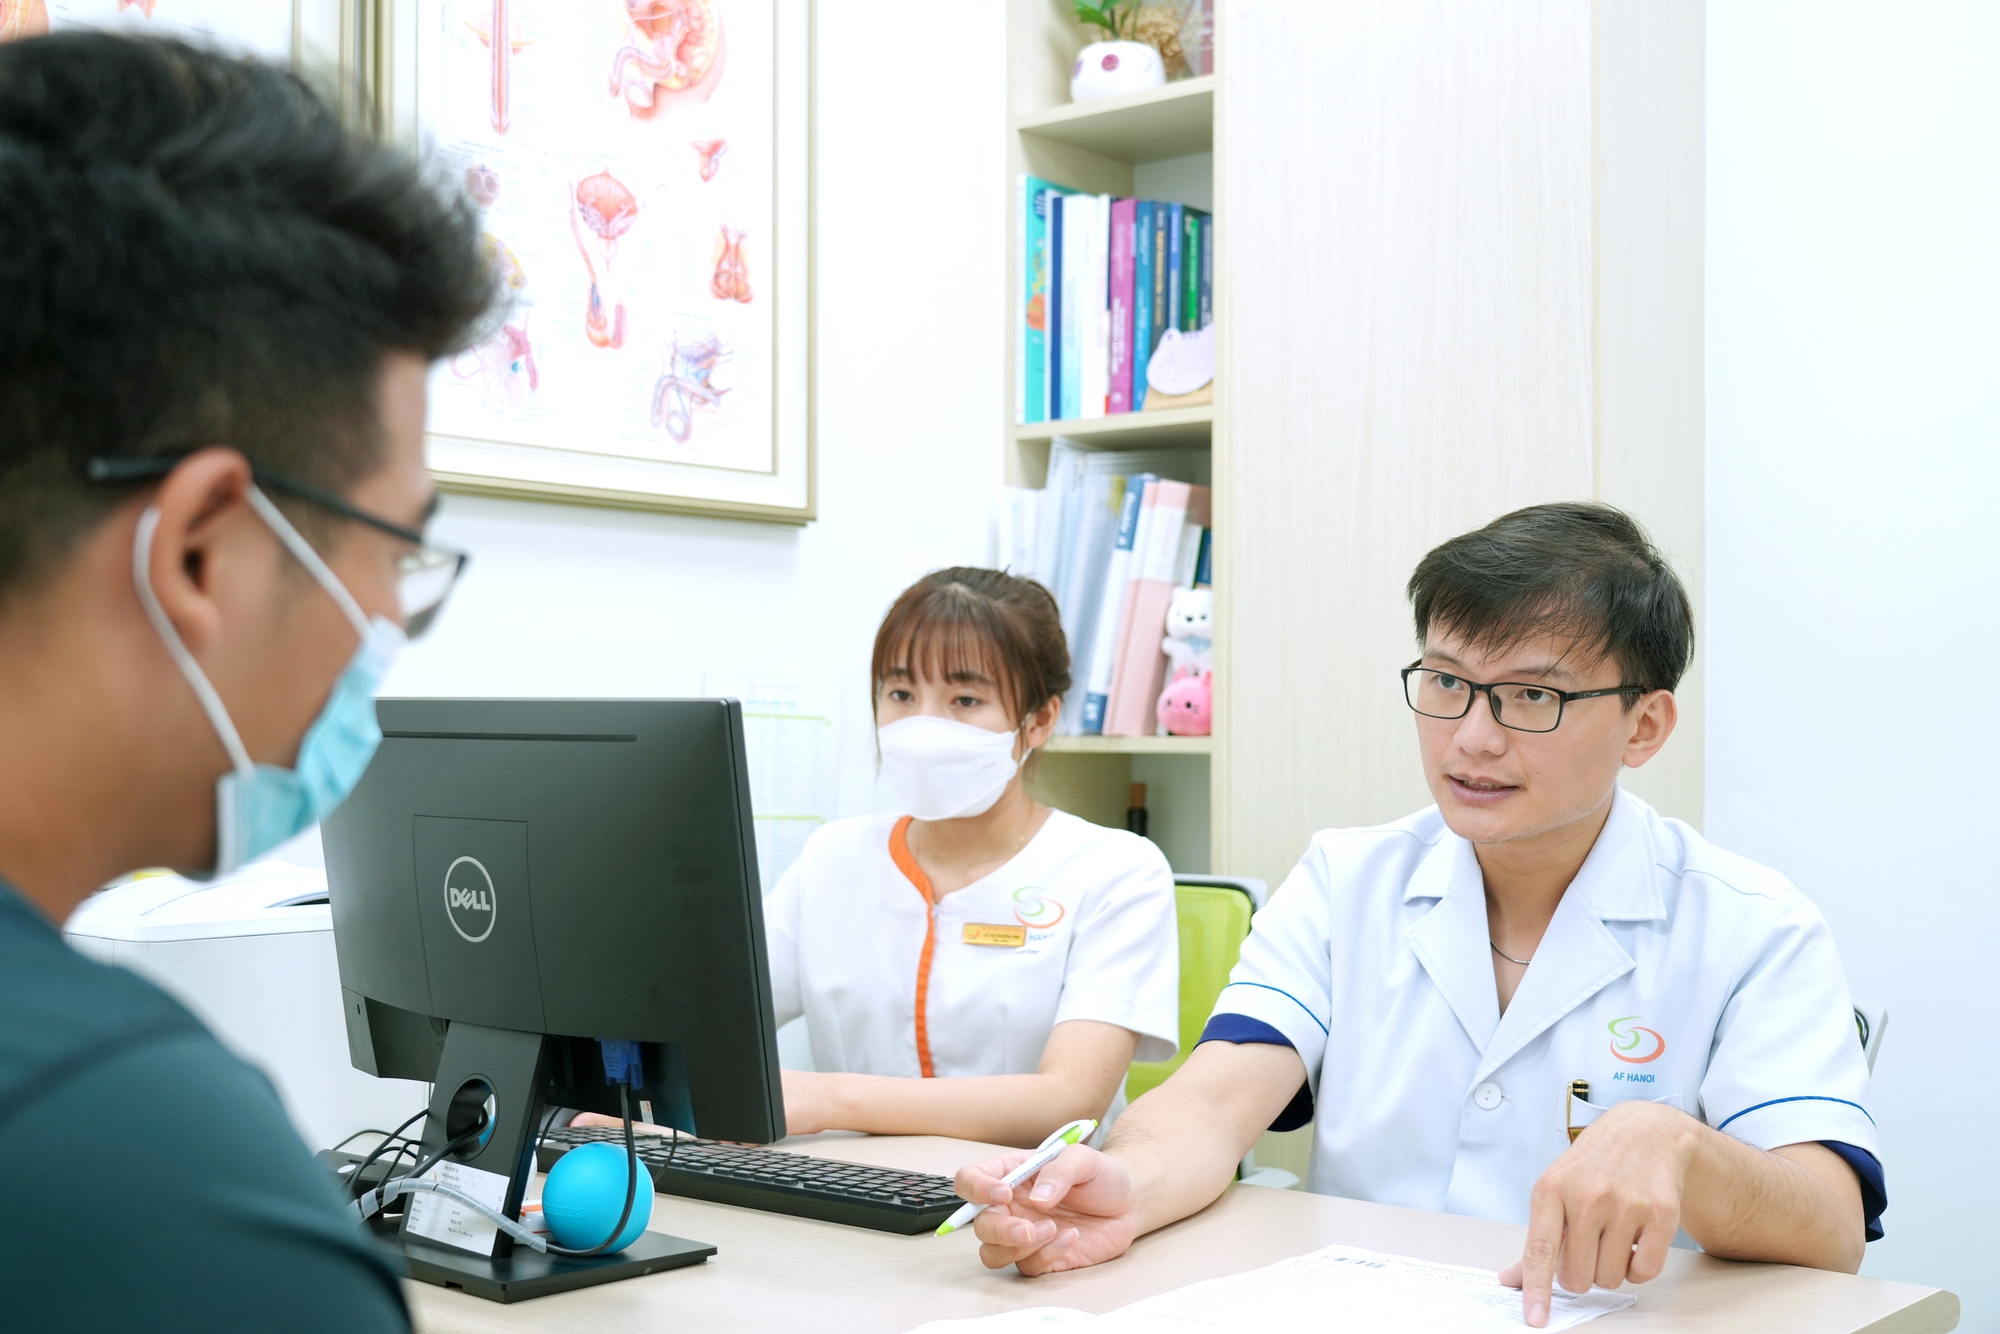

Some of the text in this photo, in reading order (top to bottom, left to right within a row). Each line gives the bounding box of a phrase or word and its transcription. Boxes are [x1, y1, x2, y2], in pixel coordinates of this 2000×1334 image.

[449, 887, 491, 911] DELL
[1613, 1071, 1655, 1083] AF HANOI
